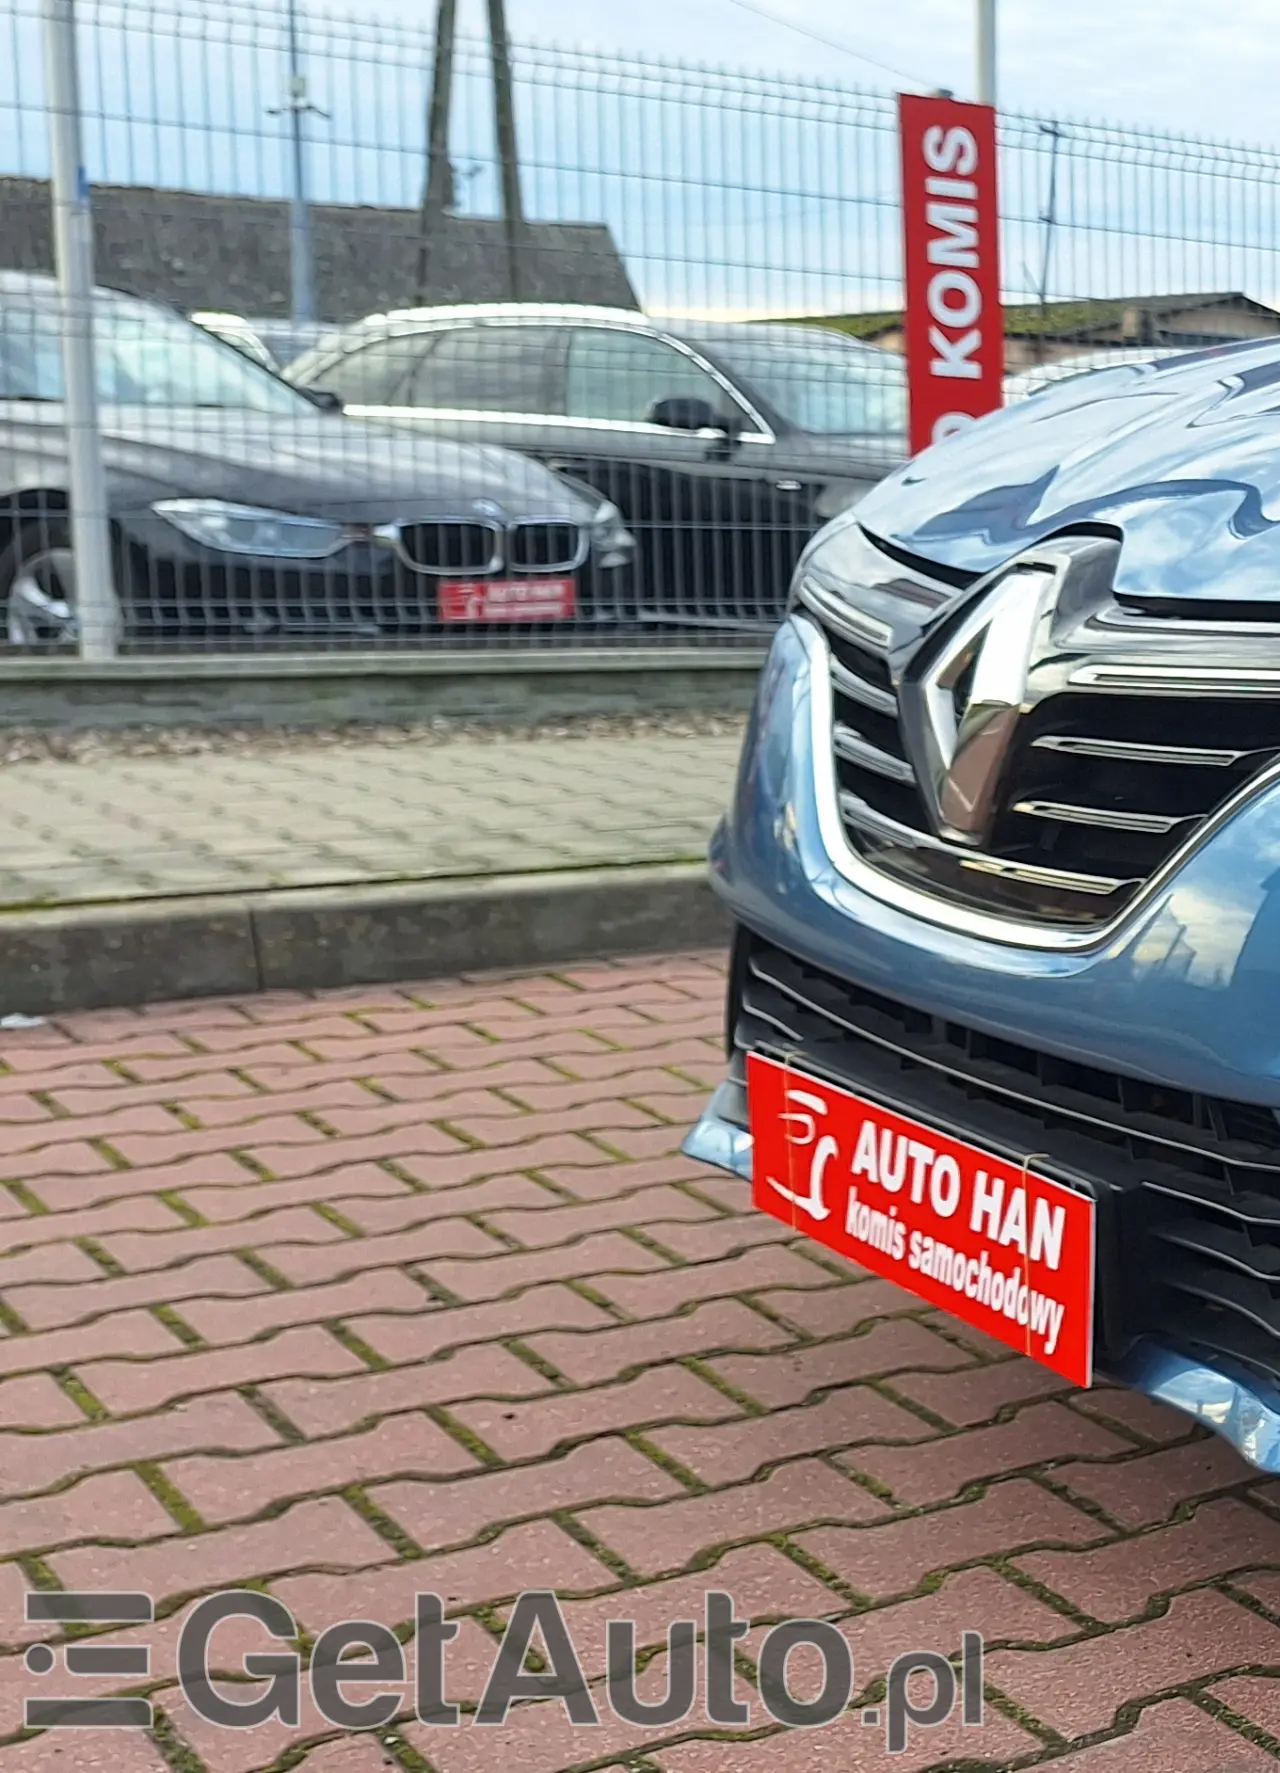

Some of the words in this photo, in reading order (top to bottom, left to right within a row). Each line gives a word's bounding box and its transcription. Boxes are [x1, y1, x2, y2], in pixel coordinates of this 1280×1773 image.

[923, 125, 983, 379] KOMIS
[845, 1186, 906, 1260] komis
[908, 1229, 1065, 1355] samochodowy
[851, 1120, 960, 1217] AUTO
[970, 1170, 1066, 1270] HAN
